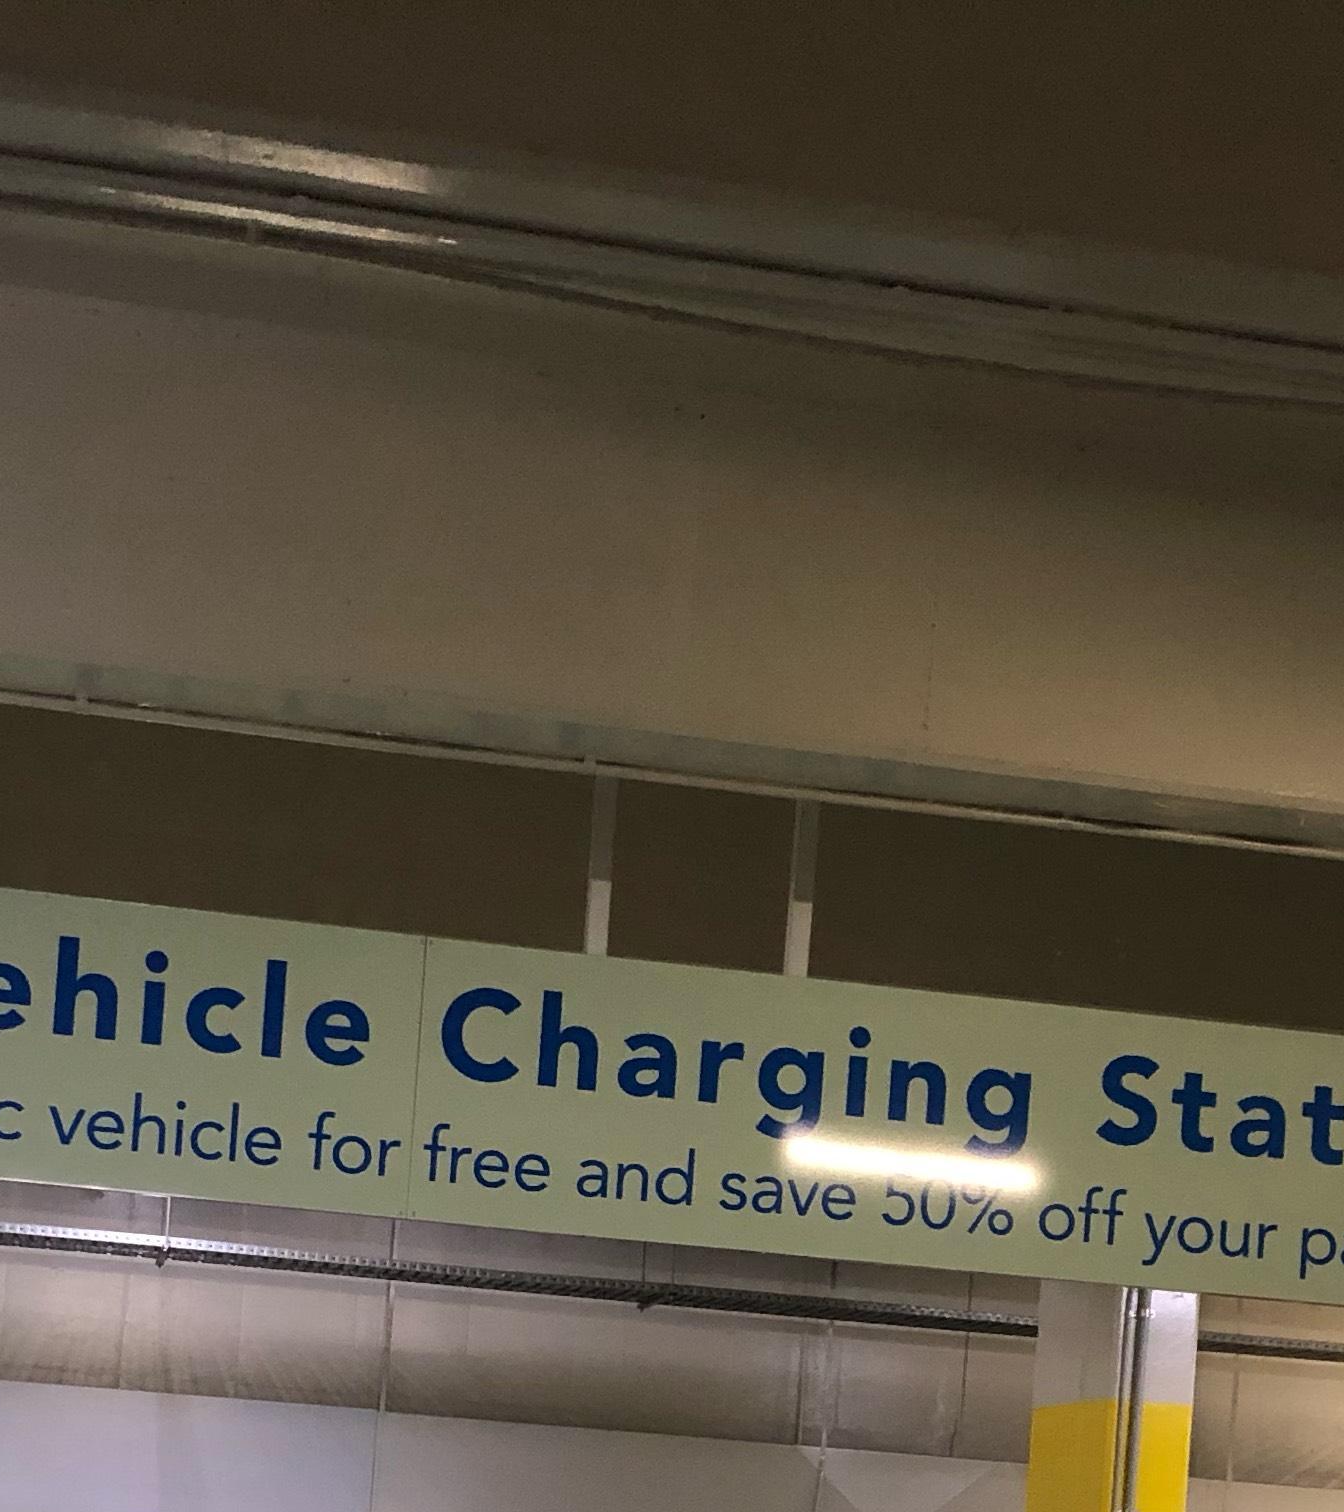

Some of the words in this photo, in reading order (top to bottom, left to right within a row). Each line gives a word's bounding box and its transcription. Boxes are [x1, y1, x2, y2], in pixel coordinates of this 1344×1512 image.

[441, 986, 1033, 1156] Charging
[49, 1093, 282, 1170] vehicle
[309, 1111, 402, 1178] for
[424, 1123, 550, 1193] free
[576, 1148, 696, 1206] and
[719, 1169, 856, 1221] save
[882, 1174, 1014, 1235] 50%
[1039, 1187, 1128, 1245] off
[1141, 1209, 1278, 1266] your
